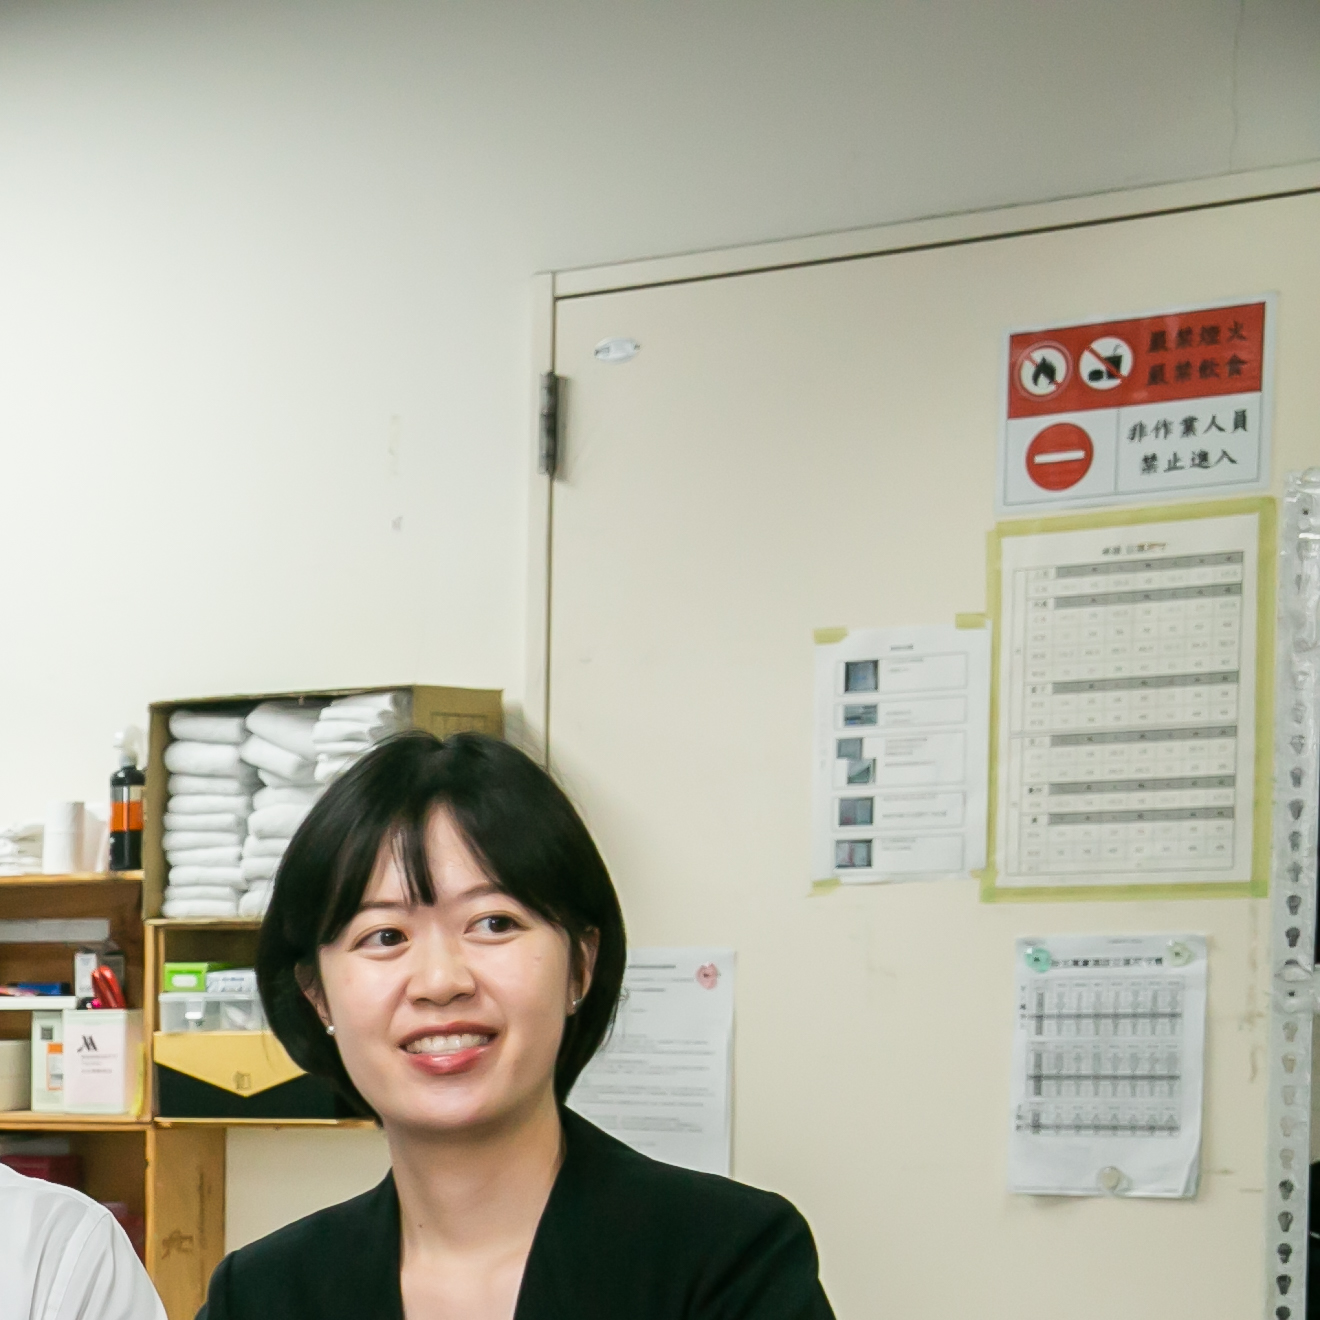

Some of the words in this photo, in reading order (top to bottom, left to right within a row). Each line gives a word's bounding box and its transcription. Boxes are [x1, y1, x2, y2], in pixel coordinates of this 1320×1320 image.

[1128, 409, 1248, 443] 非作業人員
[1141, 449, 1237, 475] 禁止進入
